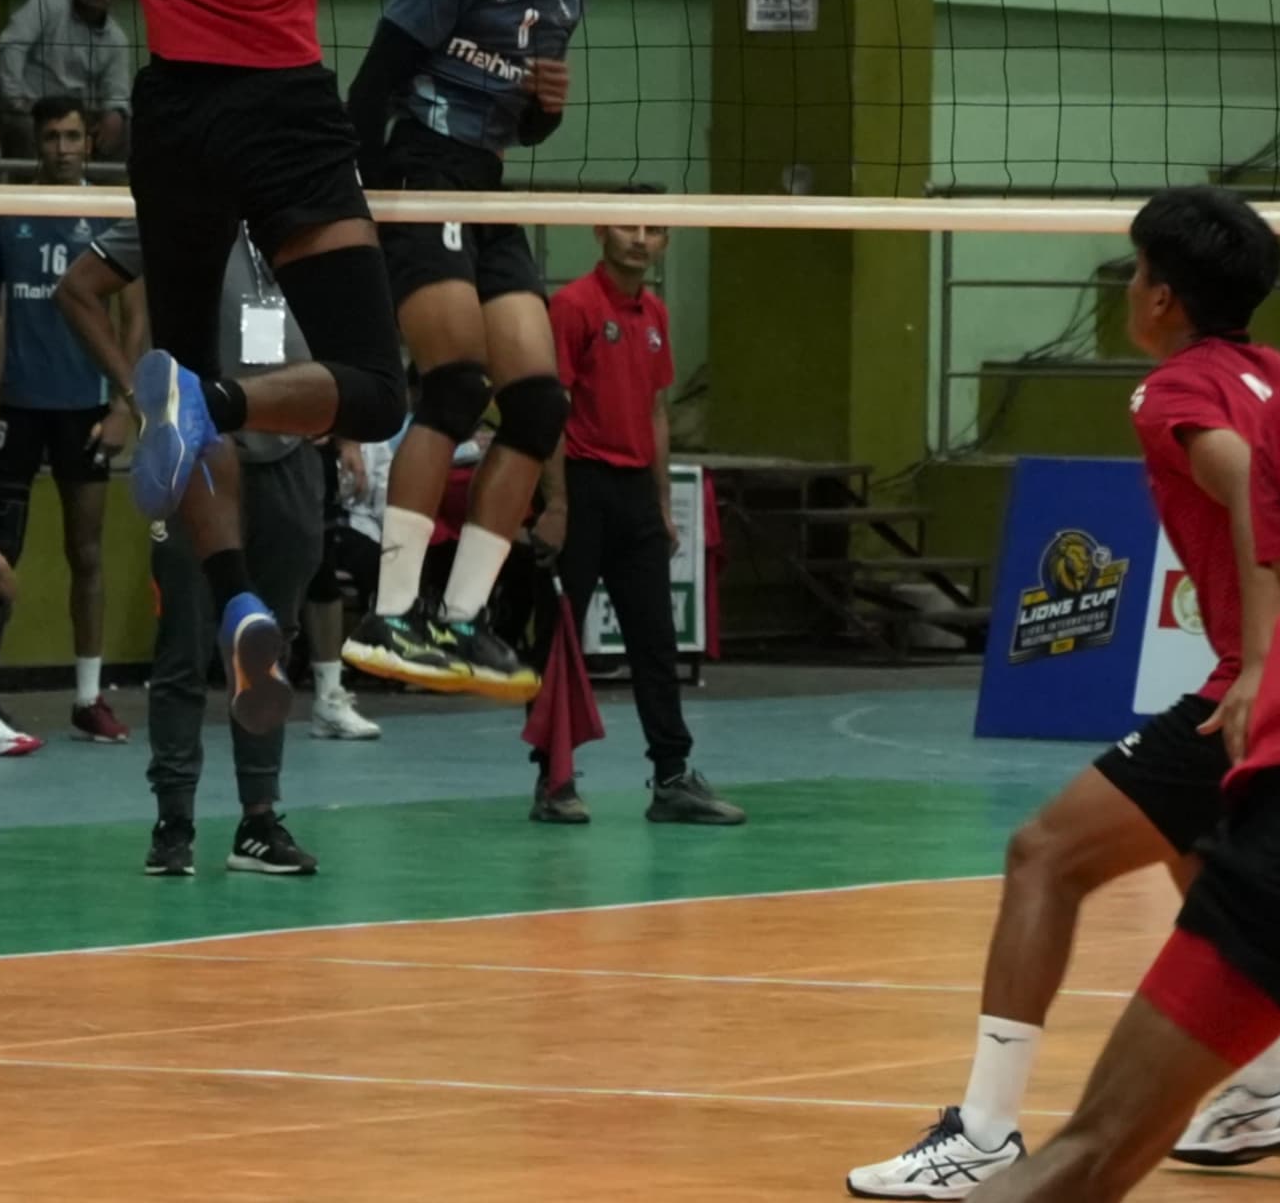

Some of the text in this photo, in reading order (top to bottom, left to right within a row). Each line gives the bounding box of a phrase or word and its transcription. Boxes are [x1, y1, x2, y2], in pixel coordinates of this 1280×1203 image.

[39, 243, 68, 275] 16
[1019, 598, 1074, 625] LIONS
[1078, 588, 1118, 611] CUP
